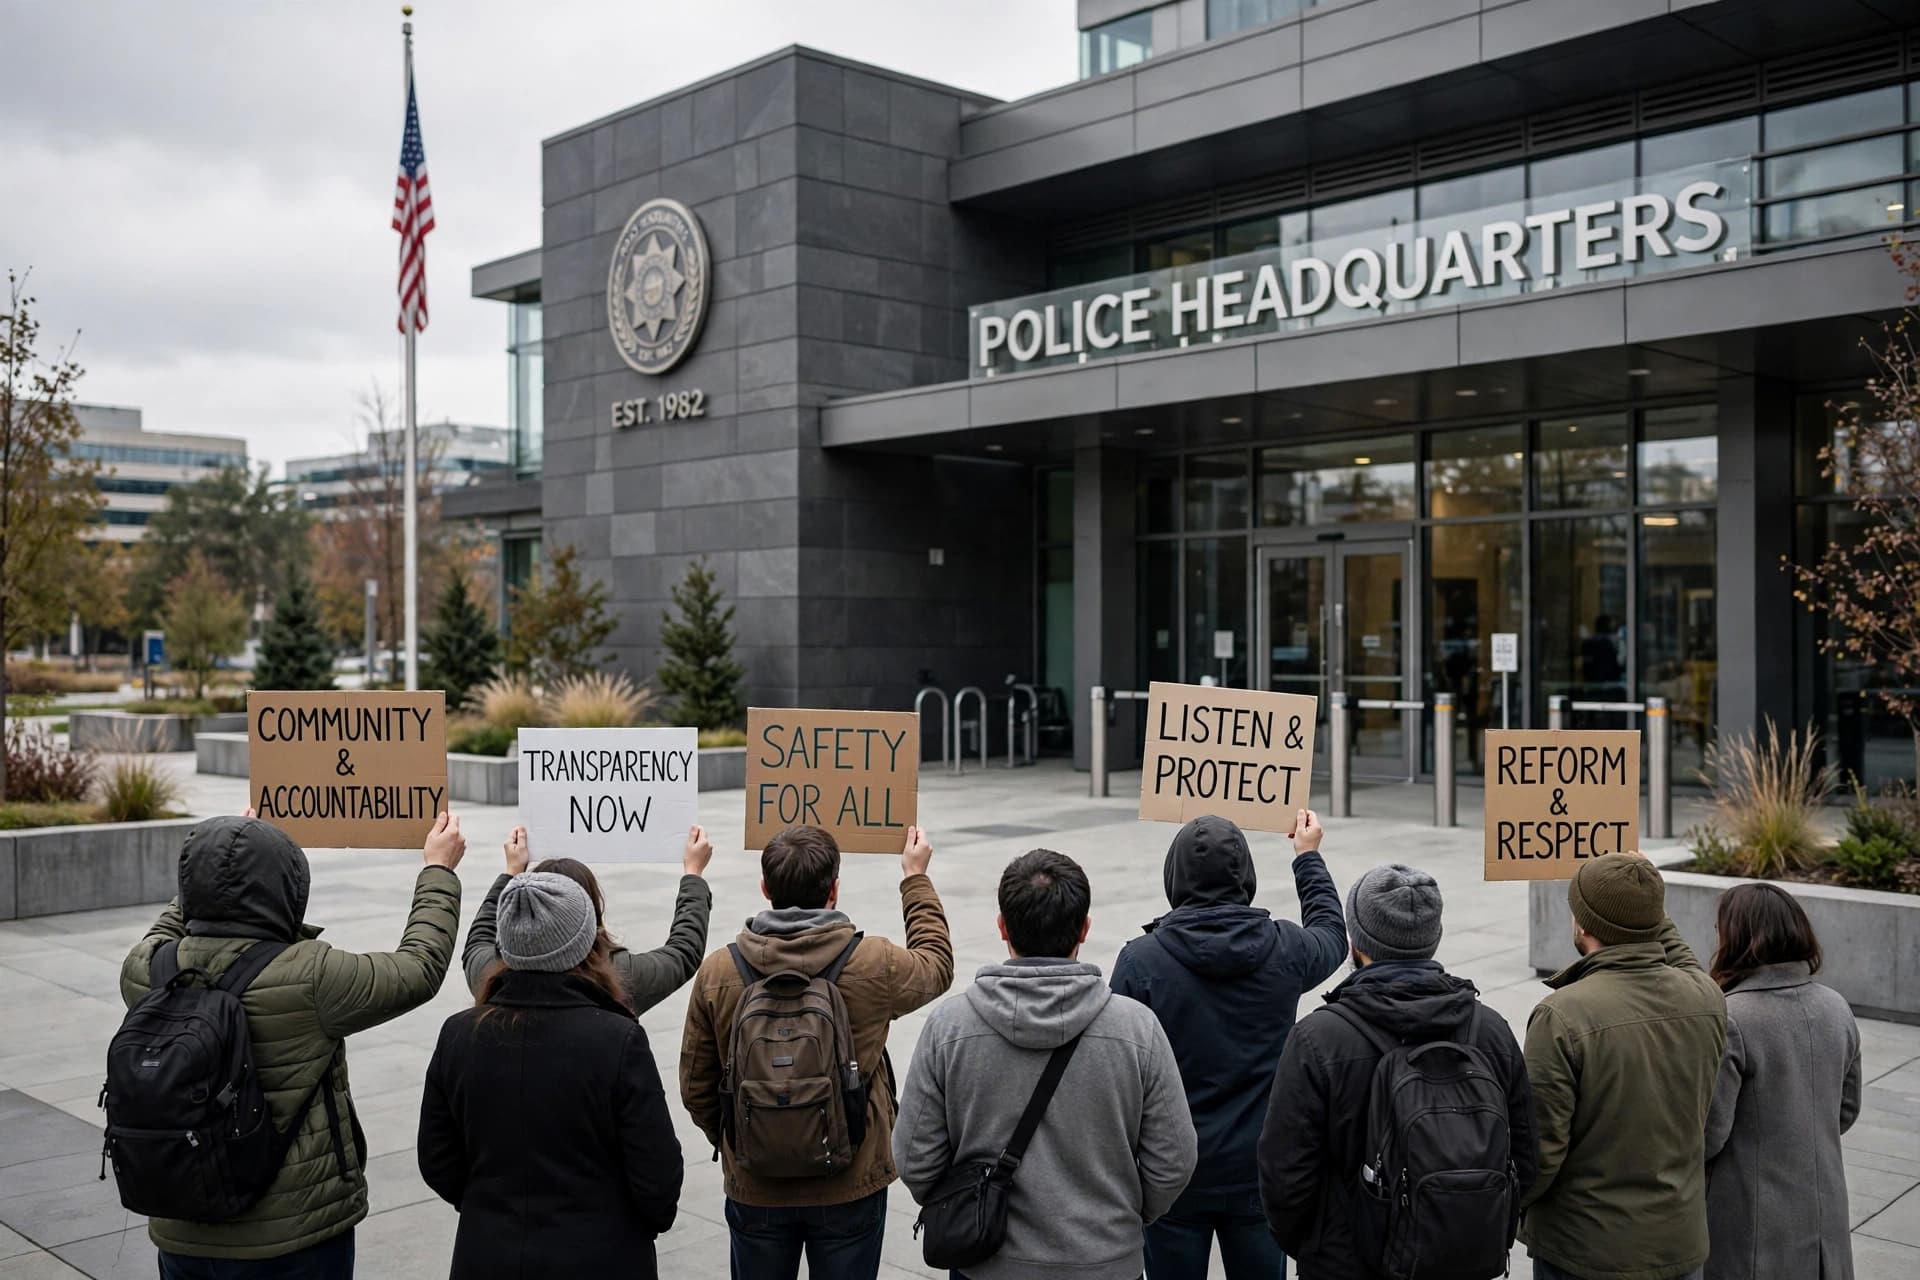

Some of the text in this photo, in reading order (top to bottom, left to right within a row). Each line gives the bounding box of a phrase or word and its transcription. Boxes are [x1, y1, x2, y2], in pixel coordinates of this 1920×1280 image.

[979, 181, 1724, 367] POLICE HEADQUARTERS
[611, 388, 704, 428] EST. 1982
[258, 707, 431, 742] COMMUNITY
[1160, 702, 1304, 750] LISTEN &
[336, 748, 356, 777] &
[523, 750, 693, 783] TRANSPARENCY
[761, 724, 907, 773] SAFETY
[1499, 745, 1626, 786] REFORM
[1155, 755, 1301, 805] PROTECT
[257, 785, 444, 820] ACCOUNTABILITY
[571, 795, 652, 834] NOW
[759, 784, 904, 827] FOR ALL
[1550, 787, 1569, 816] &
[1498, 821, 1630, 860] RESPECT
